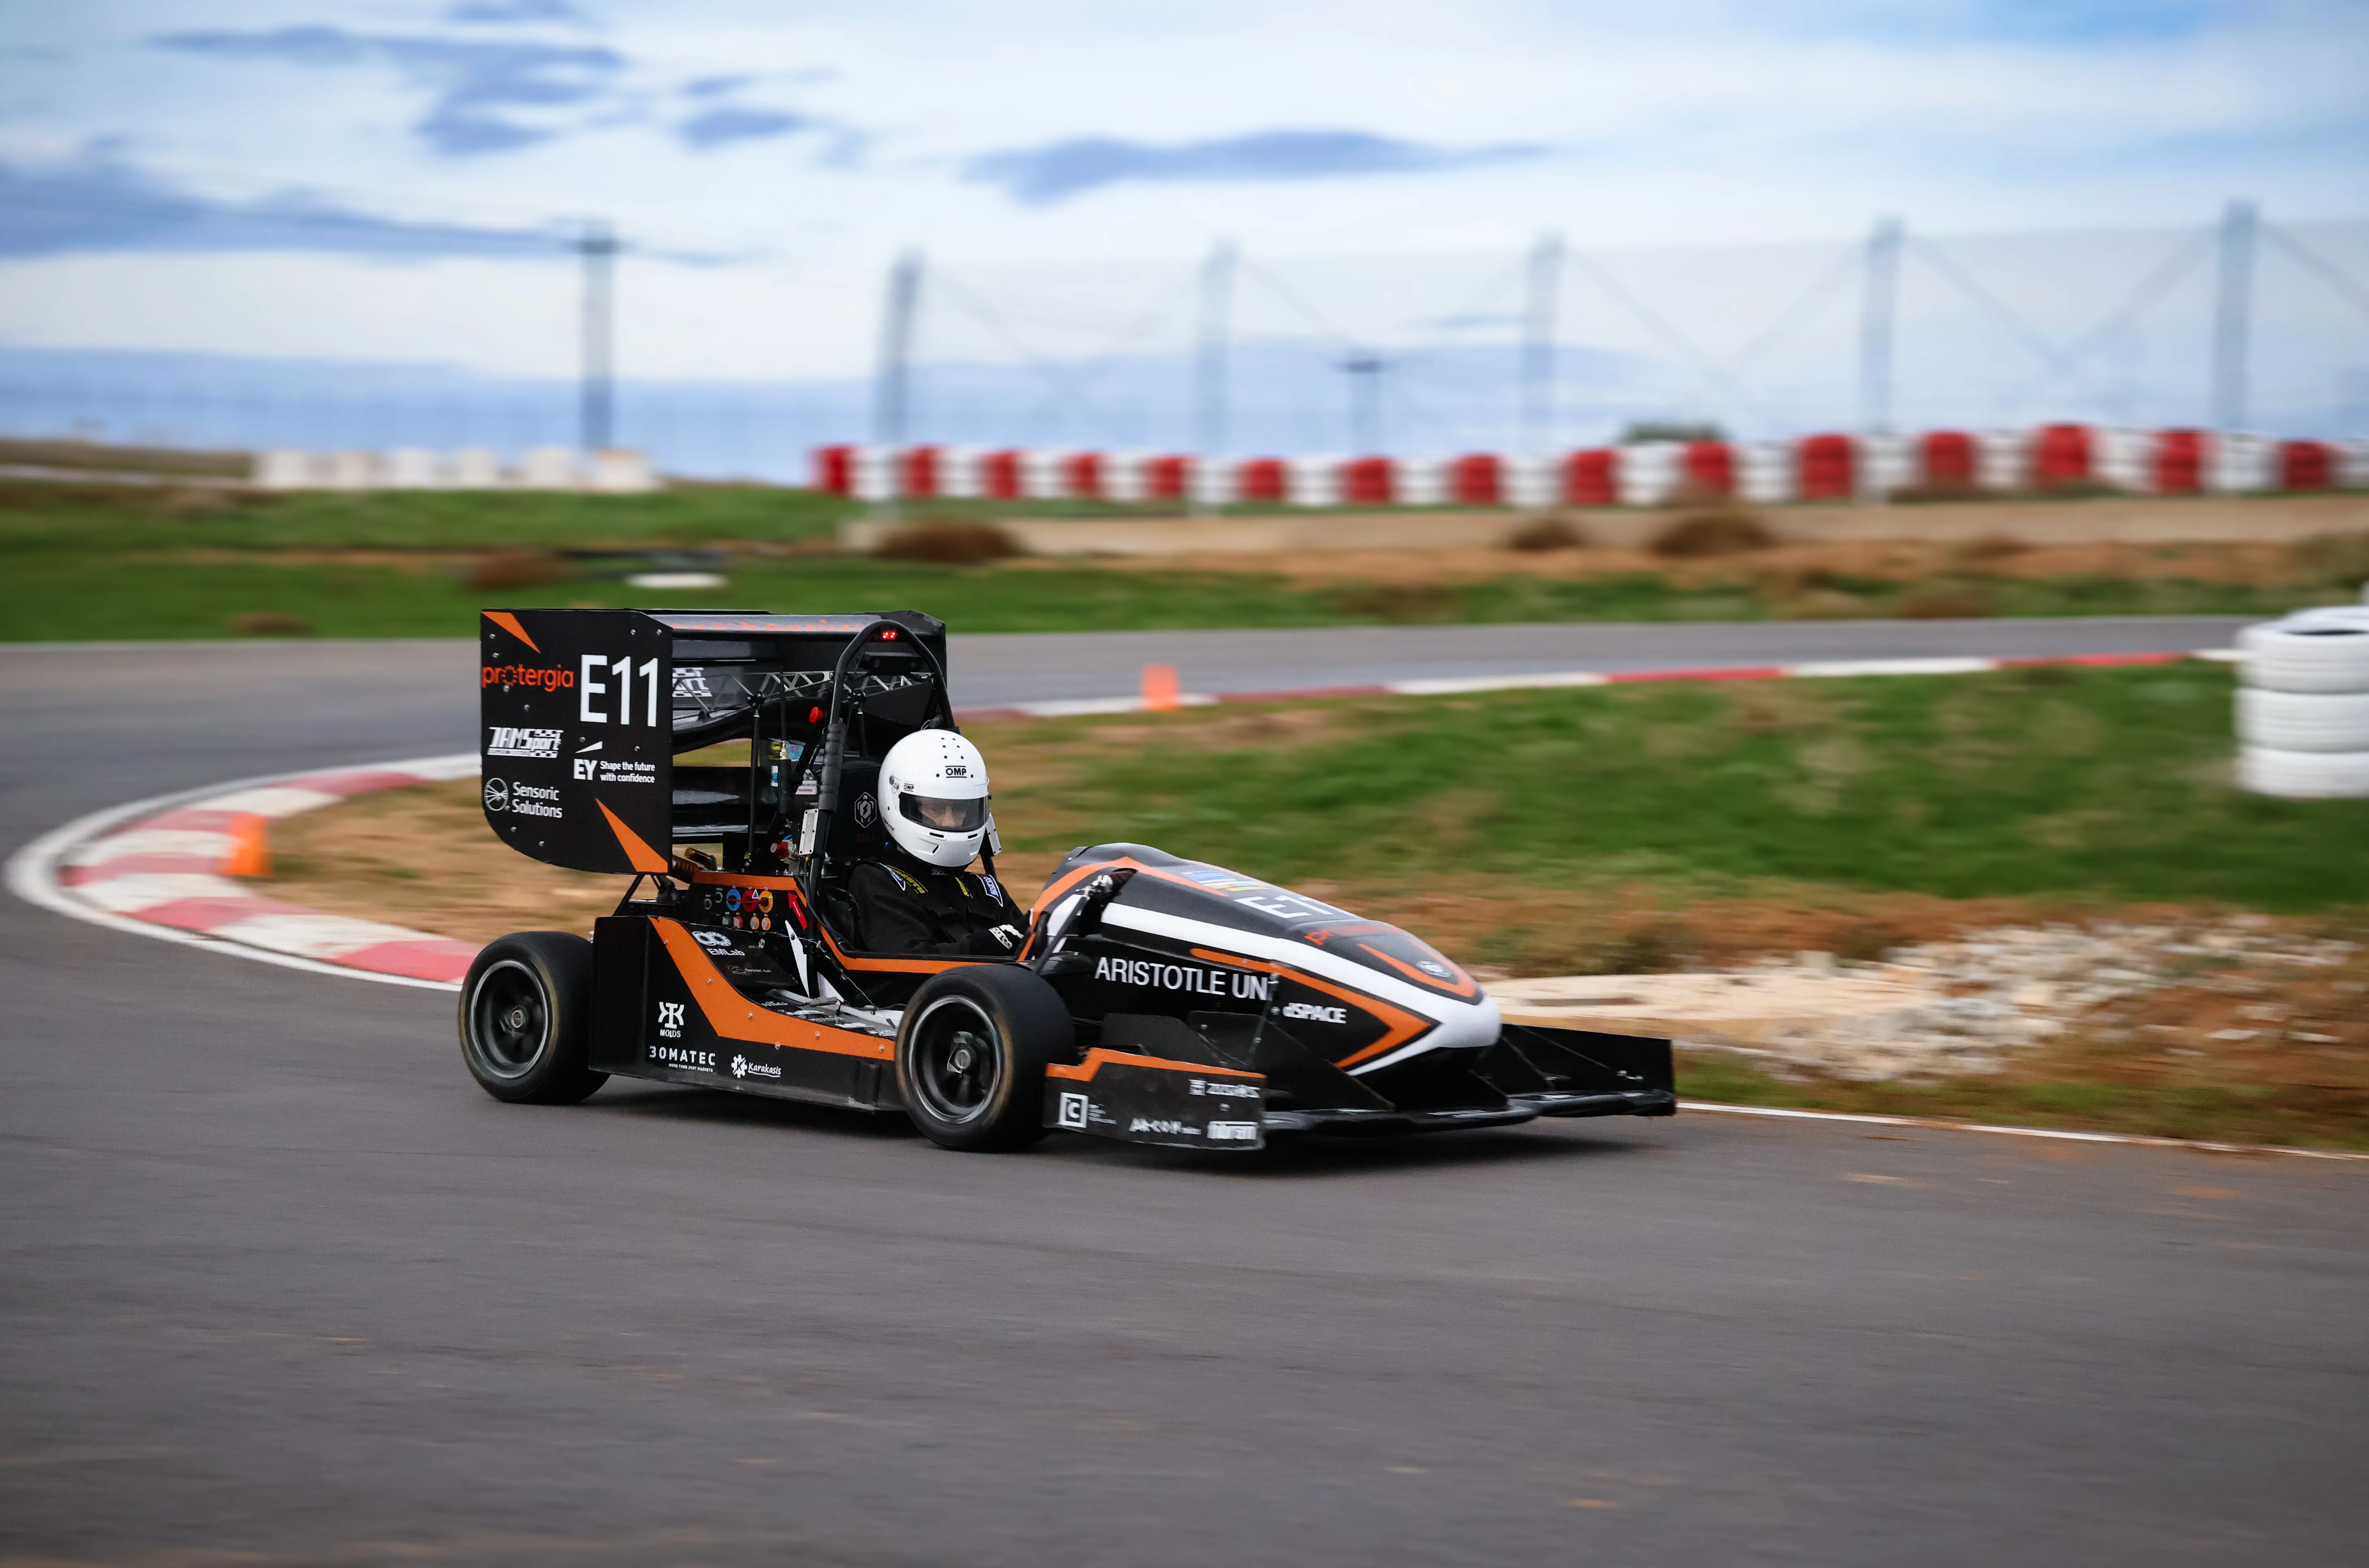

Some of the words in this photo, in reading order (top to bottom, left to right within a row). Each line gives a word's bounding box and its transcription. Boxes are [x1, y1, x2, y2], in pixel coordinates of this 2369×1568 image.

[482, 664, 574, 692] protergia
[580, 654, 658, 727] E11
[573, 759, 597, 780] EY
[600, 761, 621, 771] Shape
[622, 762, 633, 770] the
[634, 762, 655, 771] future
[600, 773, 616, 781] with
[617, 773, 655, 783] confidence
[513, 782, 560, 801] Sensoric
[512, 799, 562, 818] Solutions
[1095, 957, 1226, 995] ARISTOTLE
[1232, 973, 1272, 1001] UN
[1283, 1002, 1347, 1024] dSPACE
[660, 1030, 681, 1038] MOLDS
[748, 1062, 781, 1075] Karakasis
